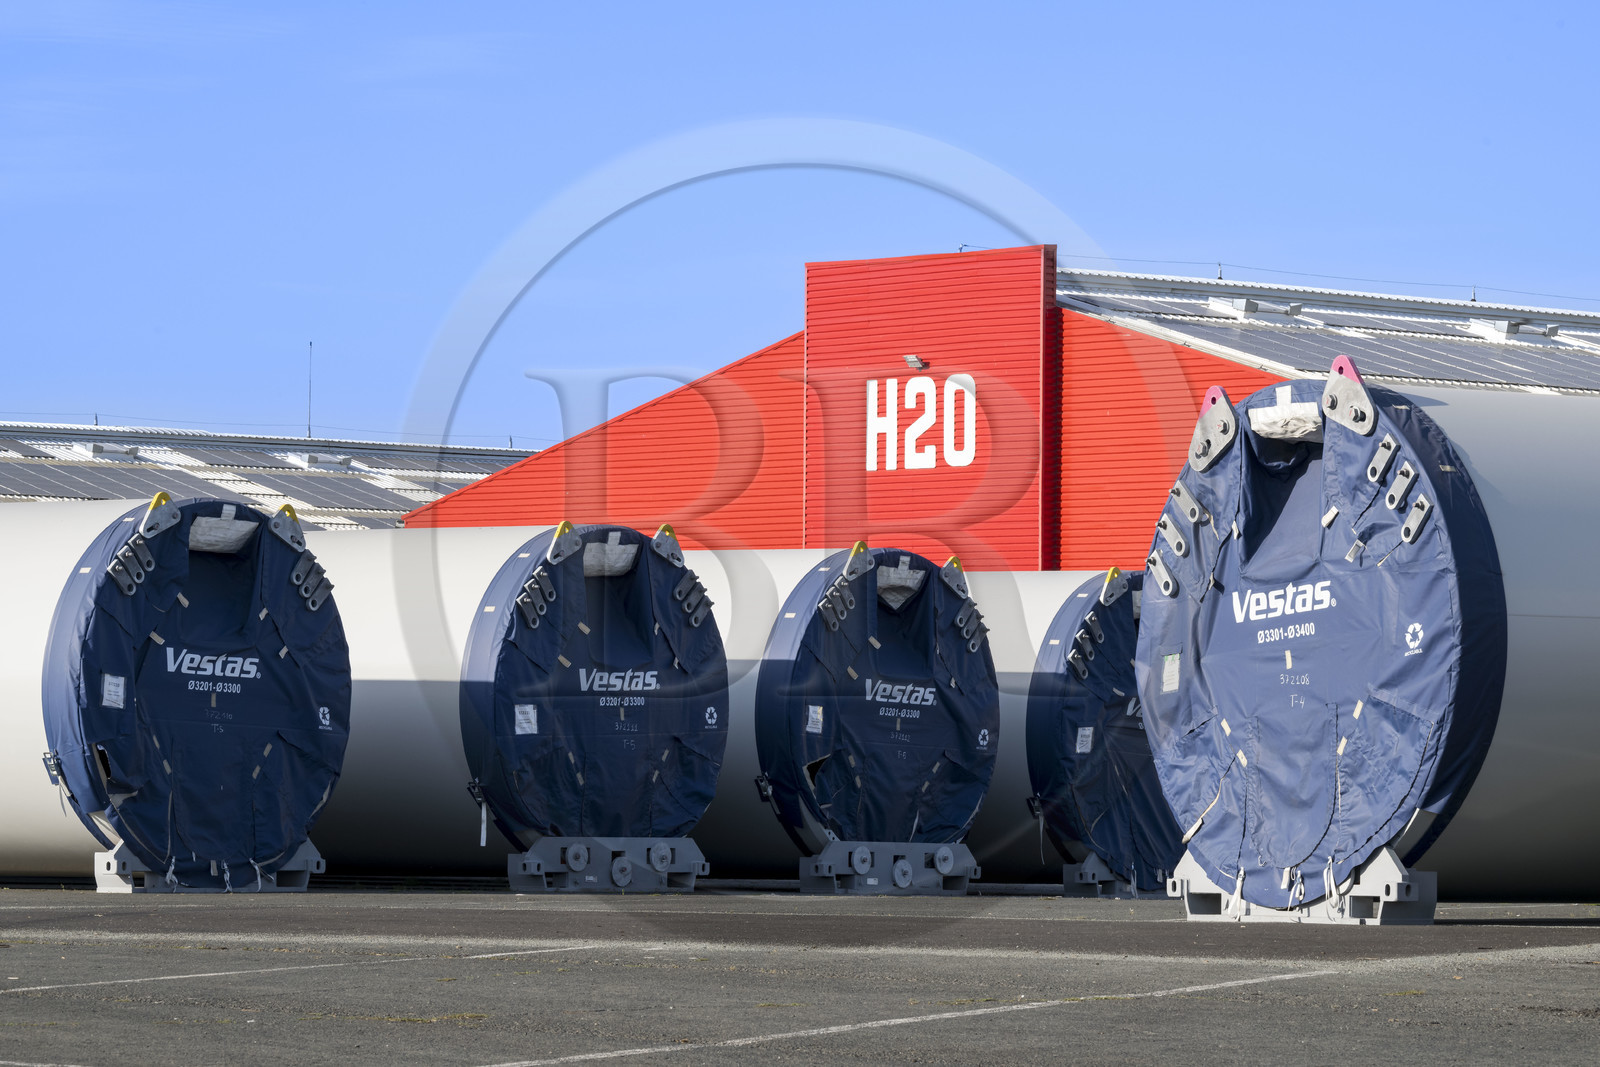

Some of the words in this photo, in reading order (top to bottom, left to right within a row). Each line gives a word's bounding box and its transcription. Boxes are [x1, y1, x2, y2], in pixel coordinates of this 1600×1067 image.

[1257, 622, 1315, 644] Ø3301-Ø3400
[1280, 673, 1310, 685] 372108
[1289, 693, 1306, 709] T-4
